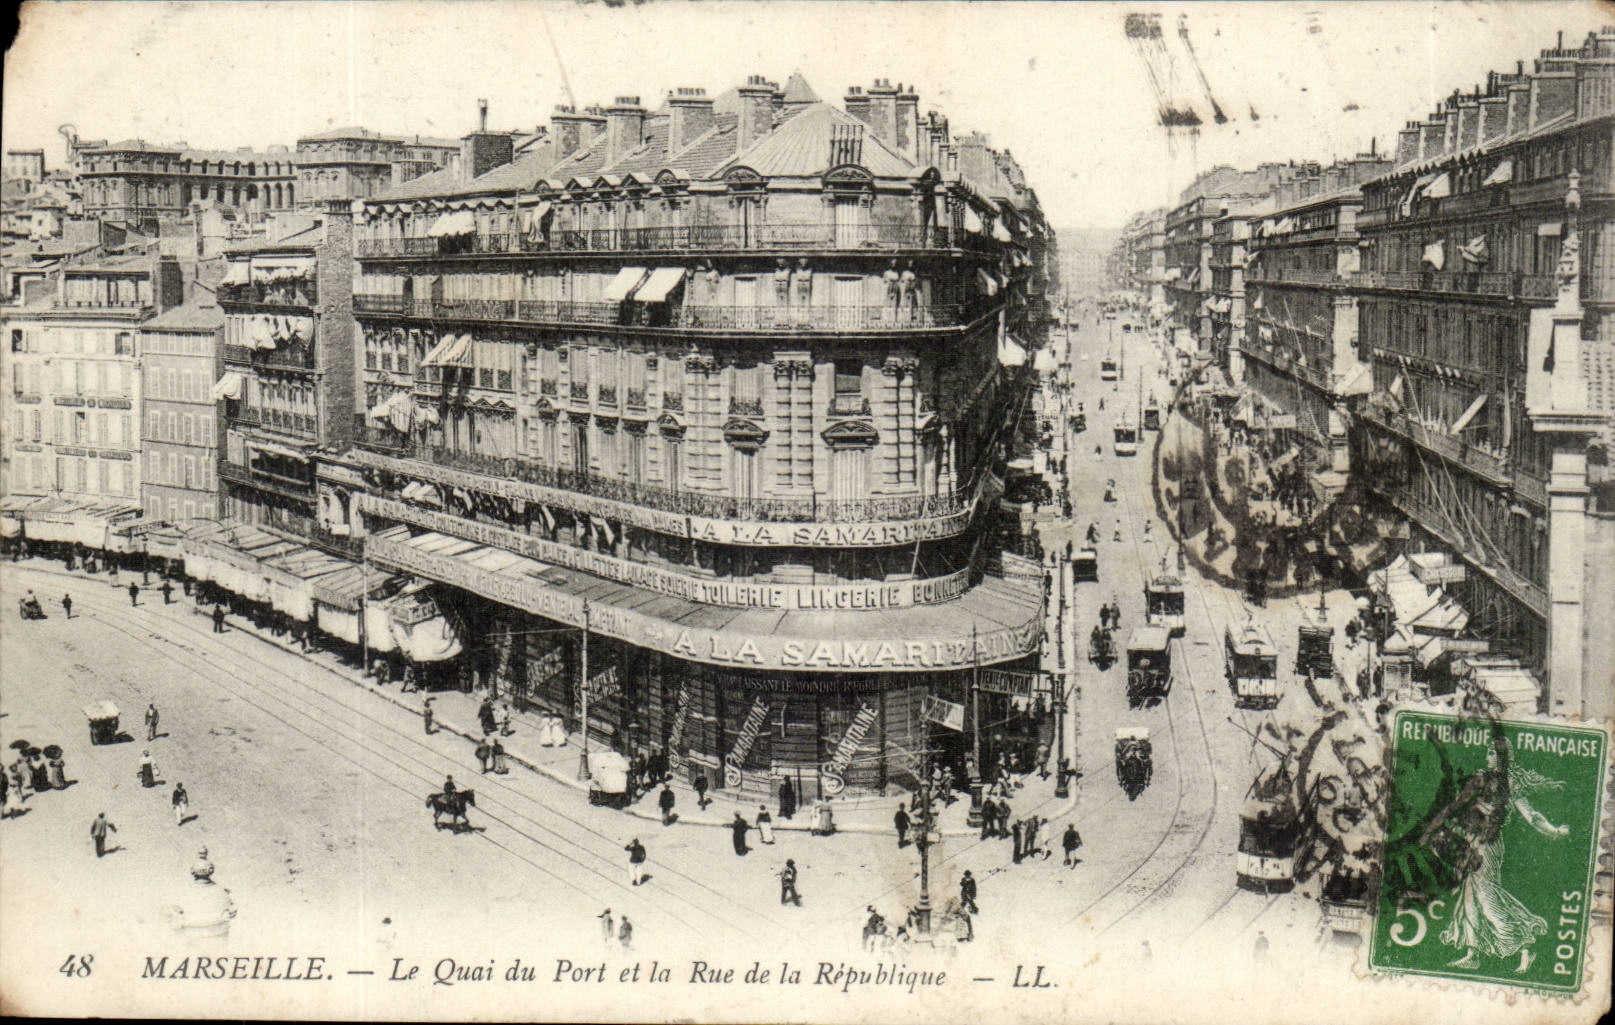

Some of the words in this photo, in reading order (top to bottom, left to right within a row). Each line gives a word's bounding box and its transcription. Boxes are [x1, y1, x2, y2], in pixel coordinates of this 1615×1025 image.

[702, 522, 720, 542] A
[732, 525, 779, 545] LA
[660, 573, 699, 600] SOIERIE
[702, 583, 782, 608] TOILERIE
[798, 586, 900, 610] LINGERIE
[673, 631, 697, 656] A
[710, 636, 764, 665] LA
[725, 695, 769, 786] SAMARITAINE
[822, 702, 879, 794] SAMARITAINE
[1517, 732, 1598, 758] FRANÇAISE
[1553, 889, 1583, 977] POSTES
